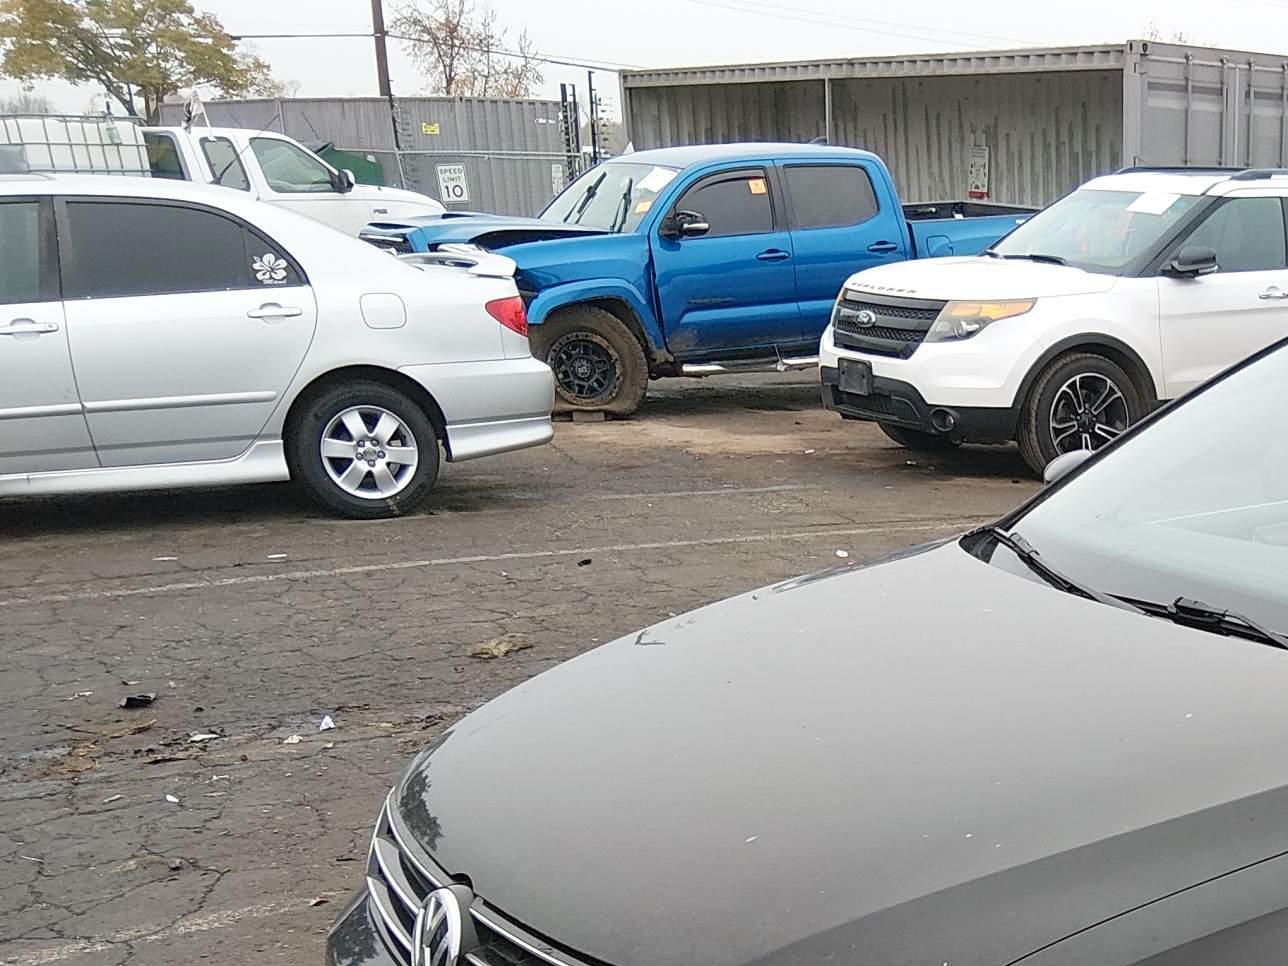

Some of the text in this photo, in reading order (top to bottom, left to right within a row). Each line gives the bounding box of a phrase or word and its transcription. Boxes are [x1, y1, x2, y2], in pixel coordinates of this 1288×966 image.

[439, 167, 463, 175] SPEED
[442, 175, 462, 183] LIMIT
[444, 184, 464, 198] 10
